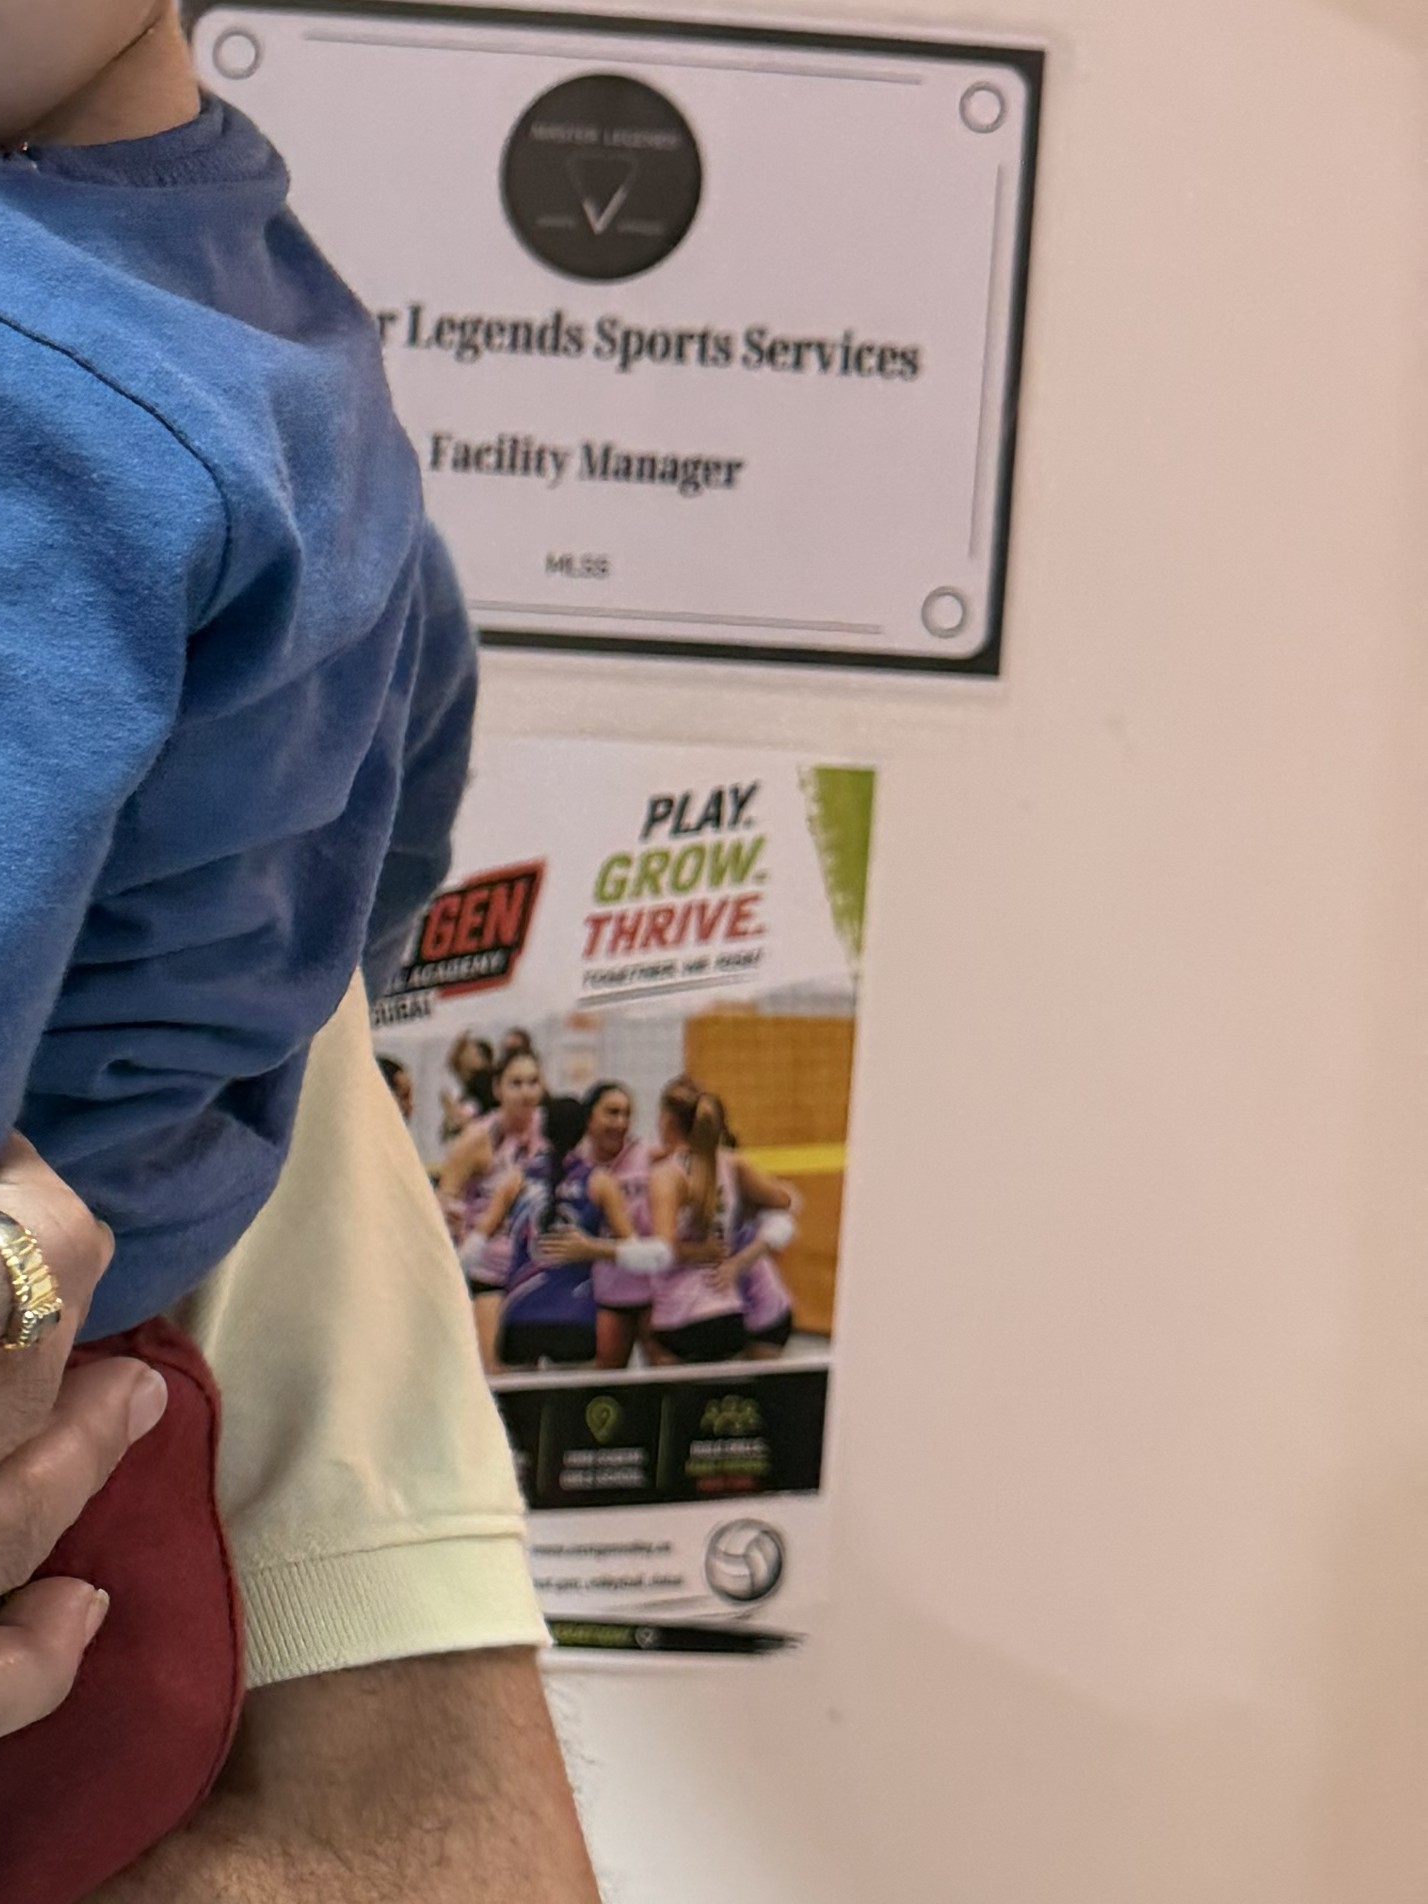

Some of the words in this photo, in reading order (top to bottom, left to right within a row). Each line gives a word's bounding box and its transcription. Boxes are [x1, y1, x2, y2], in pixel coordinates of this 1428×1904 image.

[407, 300, 585, 364] Legends
[593, 313, 732, 374] Sports
[741, 325, 921, 382] Services
[429, 432, 569, 488] Facility
[579, 441, 744, 496] Manager
[545, 551, 610, 580] MLSS
[640, 781, 759, 842] PLAY.
[593, 836, 769, 904] GROW.
[420, 880, 528, 960] GEN
[581, 893, 768, 961] THRIVE.
